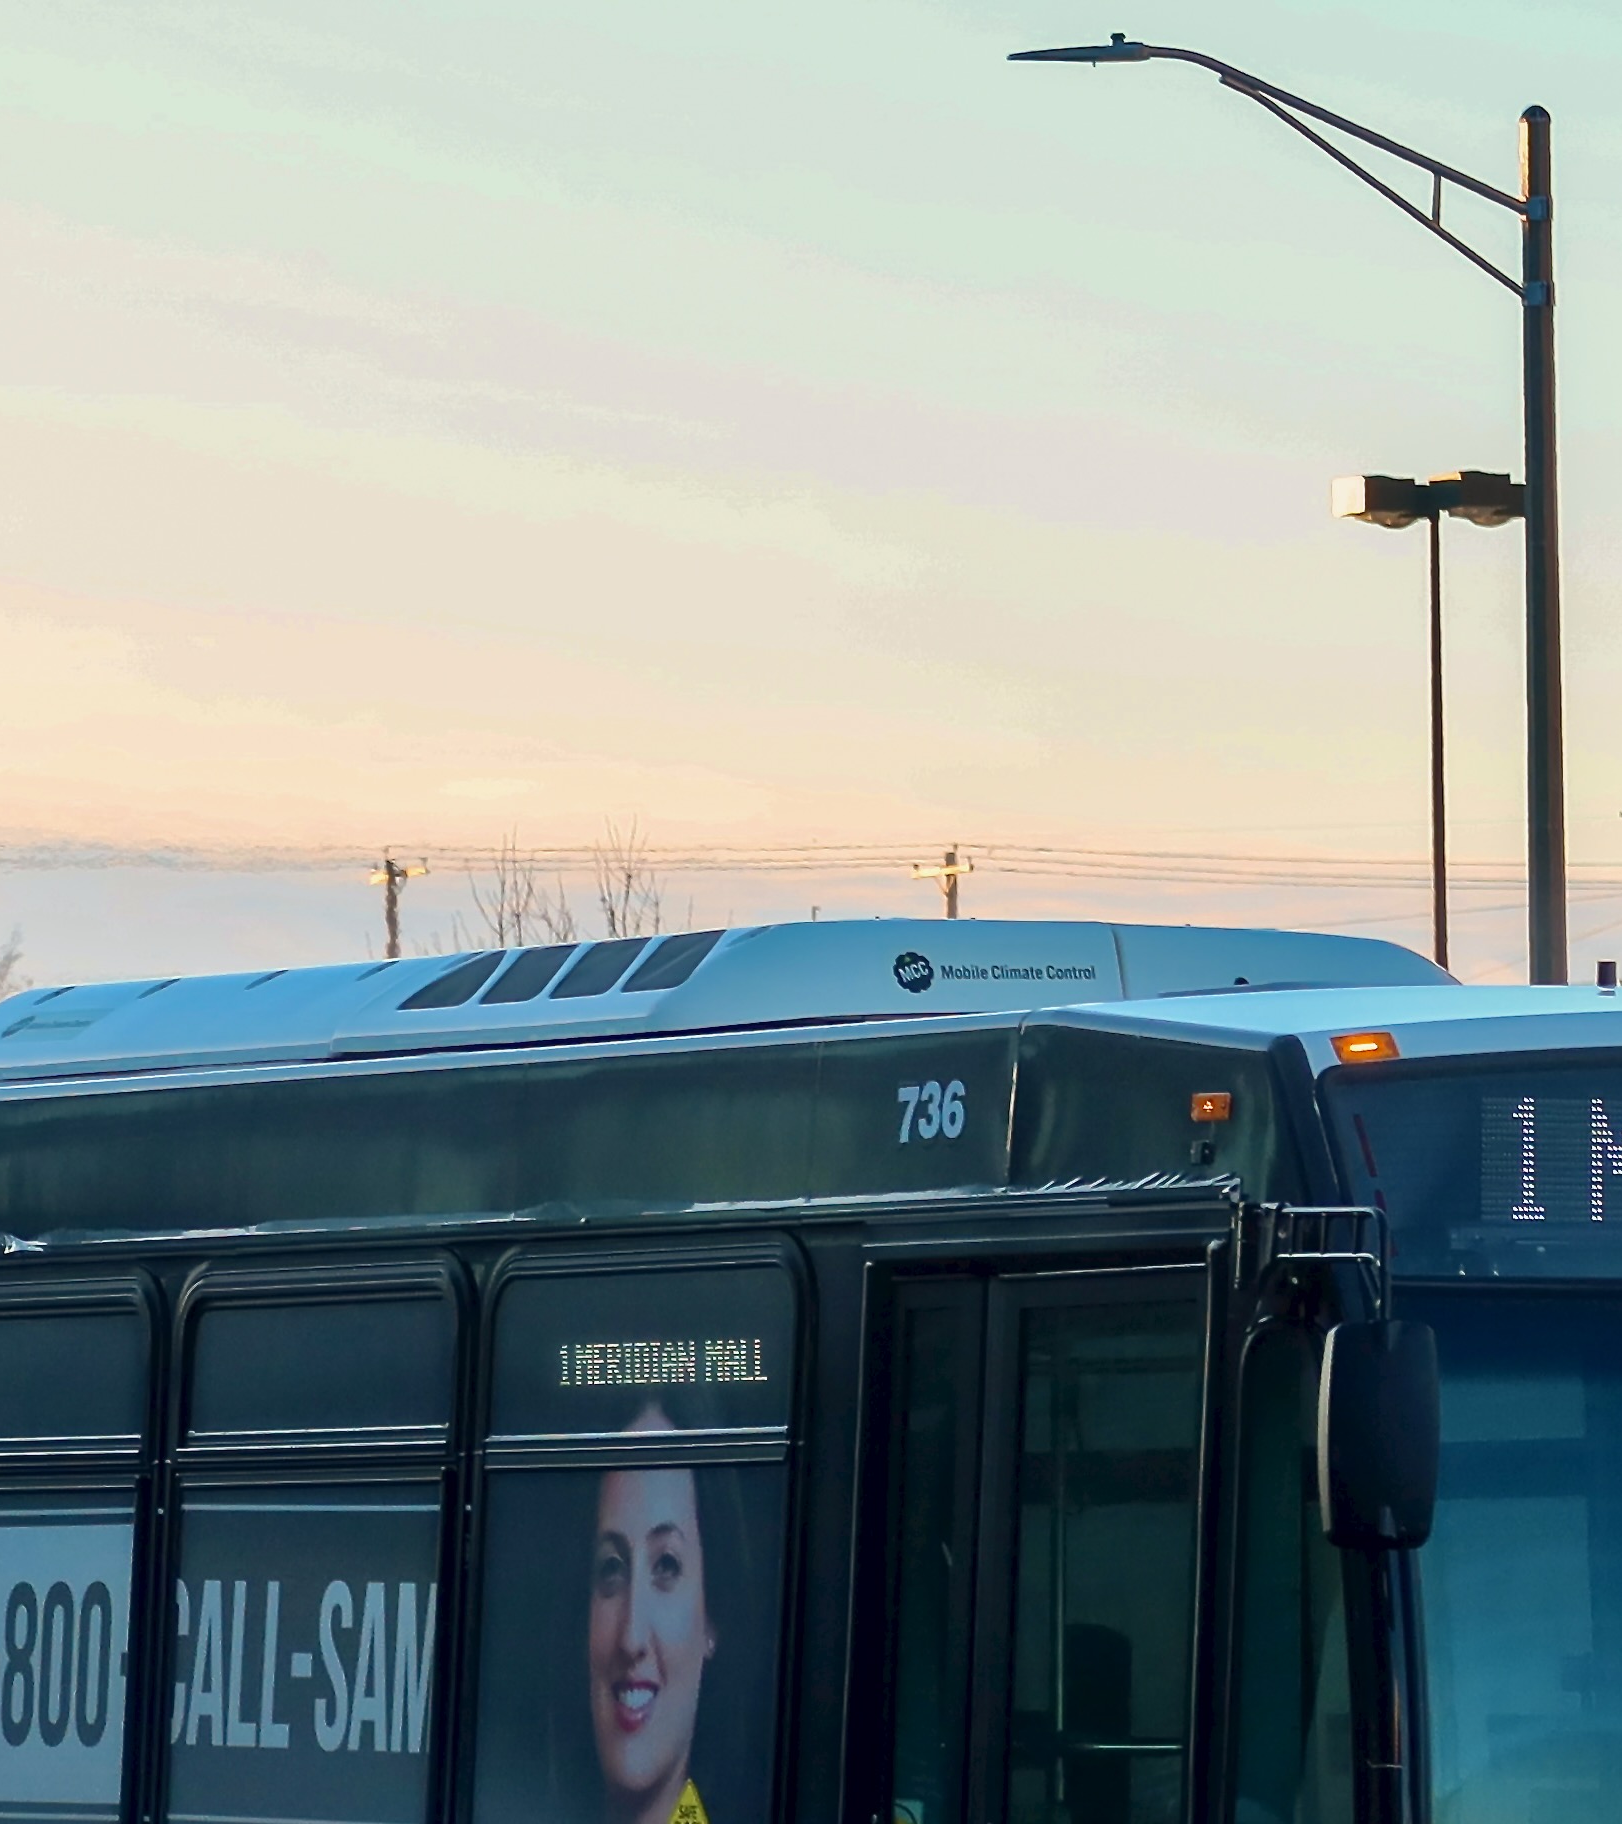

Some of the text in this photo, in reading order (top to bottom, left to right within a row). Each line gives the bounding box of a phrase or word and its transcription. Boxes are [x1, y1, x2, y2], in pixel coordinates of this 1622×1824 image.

[898, 961, 929, 983] MCC
[940, 964, 1096, 980] Mobile Climate Control
[897, 1080, 966, 1143] 736
[1510, 1096, 1545, 1222] 1
[559, 1338, 768, 1386] 1 MERIDIAN MALL
[678, 1804, 697, 1819] SAFE
